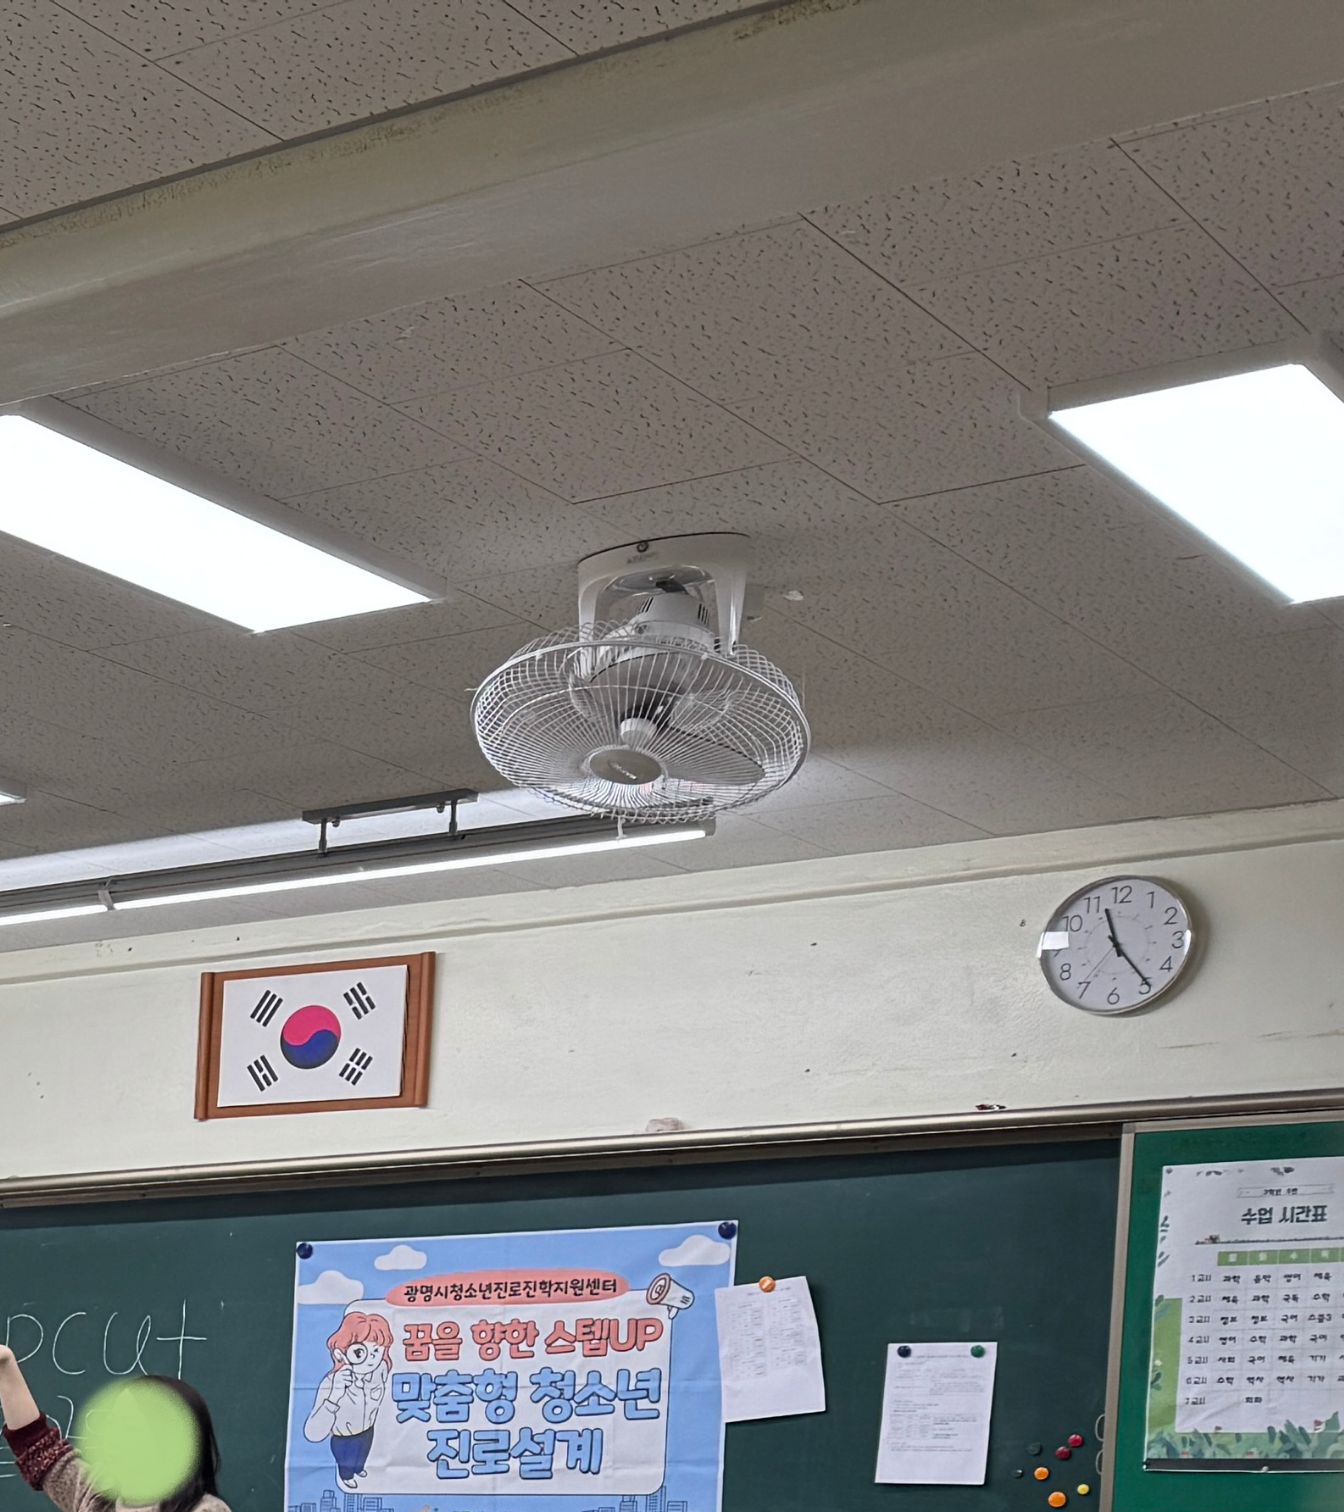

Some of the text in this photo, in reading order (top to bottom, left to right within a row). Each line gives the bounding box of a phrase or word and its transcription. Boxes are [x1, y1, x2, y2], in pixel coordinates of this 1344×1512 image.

[1112, 885, 1133, 904] 12
[1147, 891, 1155, 909] 1
[1084, 896, 1101, 914] 11
[1063, 914, 1083, 932] 10
[1164, 906, 1178, 925] 2
[1172, 931, 1185, 949] 3
[1060, 963, 1072, 981] 8
[1160, 956, 1173, 972] 4
[1078, 981, 1091, 999] 7
[1138, 977, 1152, 995] 5
[1107, 987, 1120, 1005] 6
[1241, 1205, 1328, 1225] 수업 시간표
[403, 1279, 617, 1303] 광명시청소년진로진학지원센터
[402, 1317, 664, 1361] 꿈을 향한 스텝UP
[391, 1367, 661, 1424] 맞춤형 청소년
[426, 1427, 603, 1480] 진로설계
